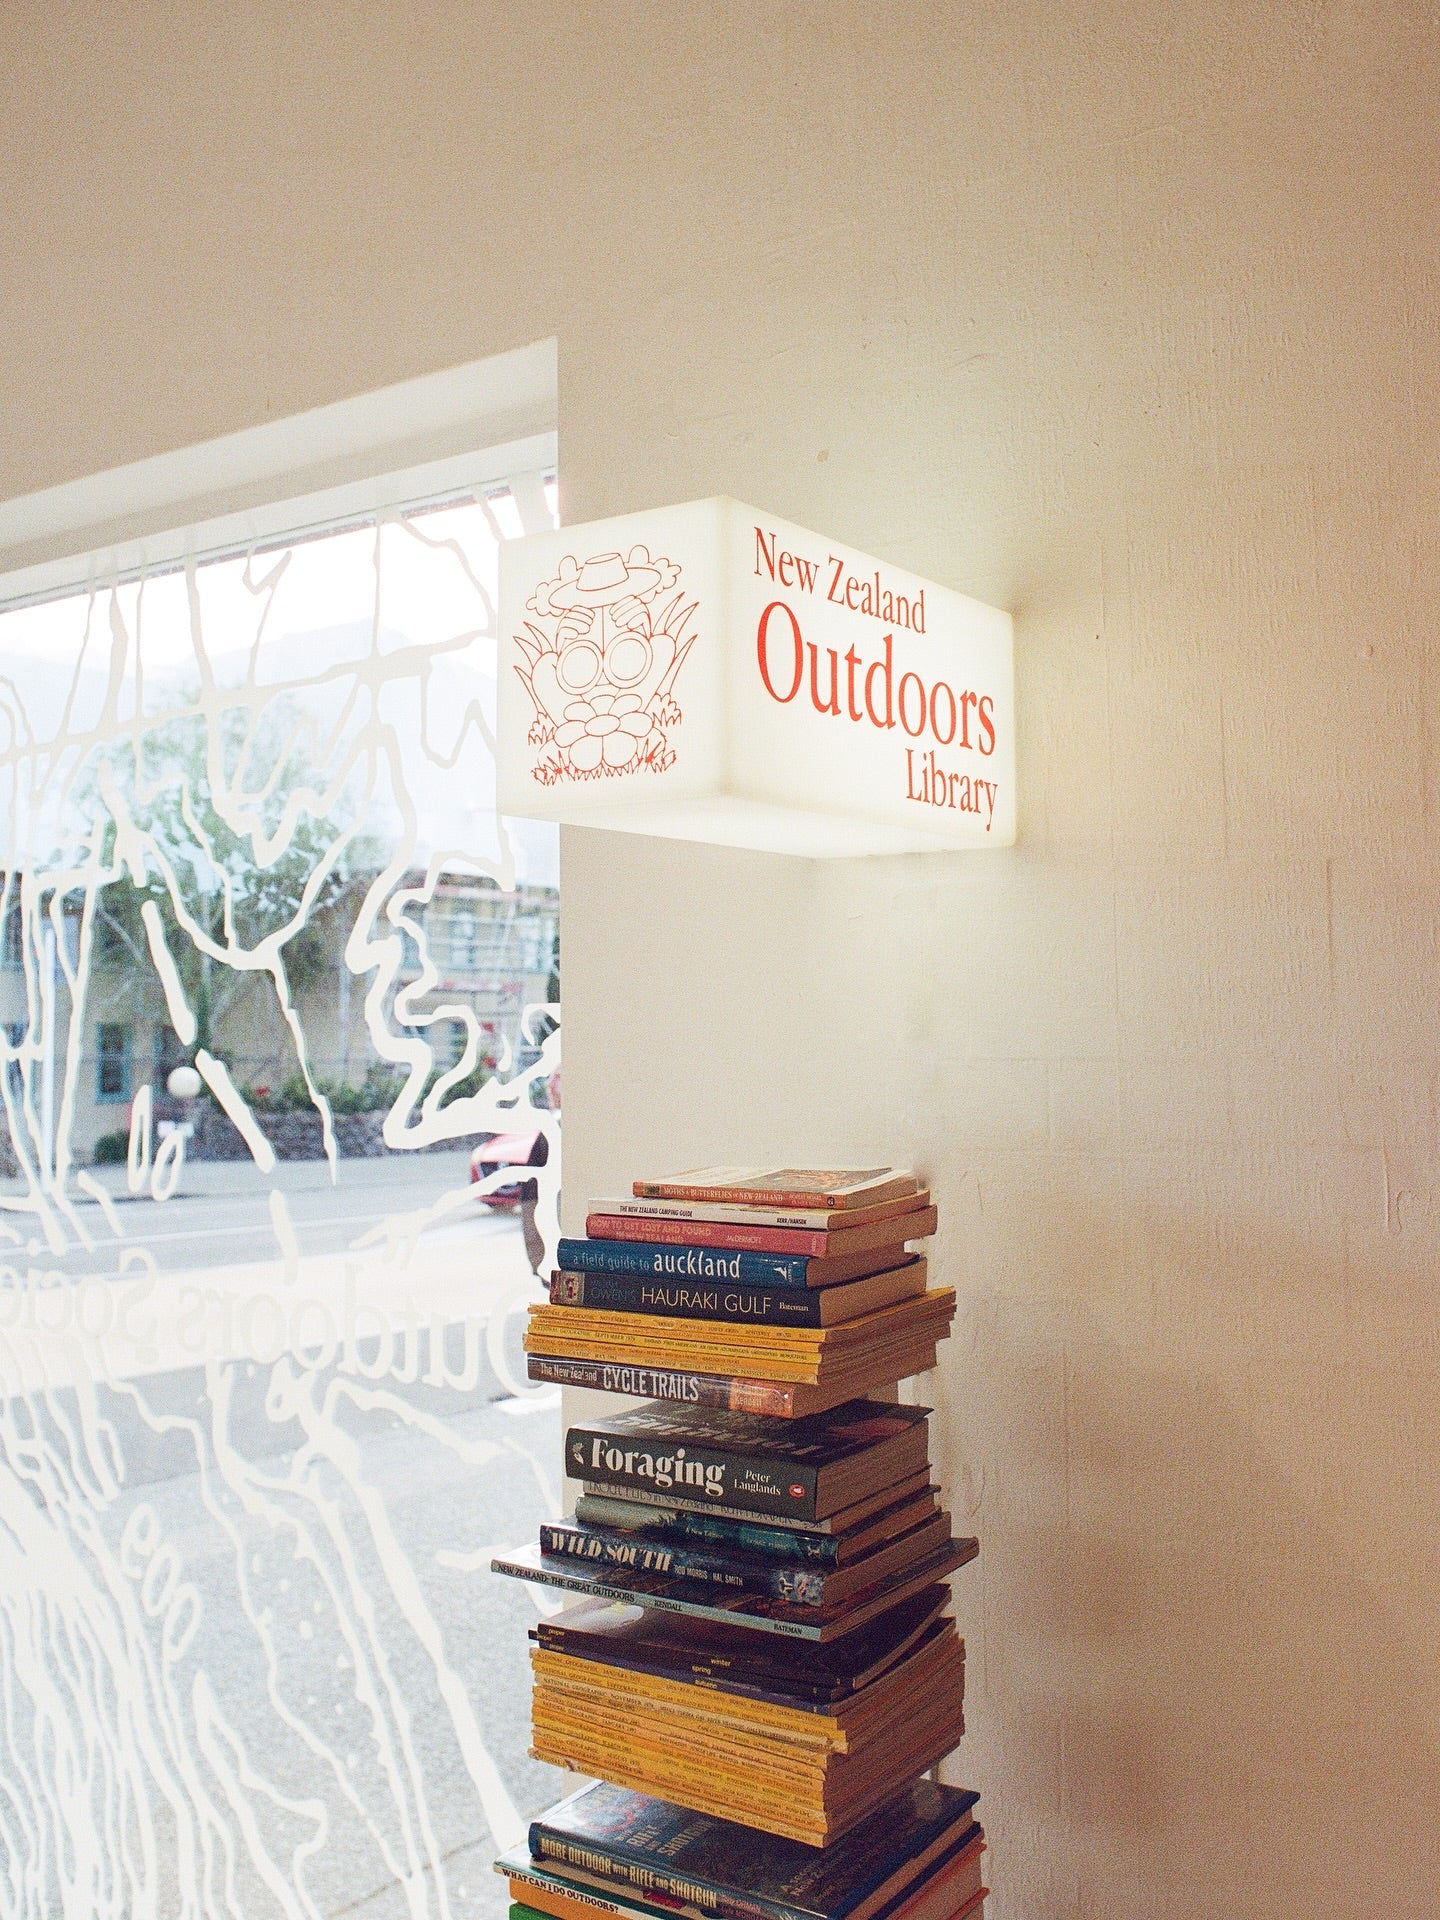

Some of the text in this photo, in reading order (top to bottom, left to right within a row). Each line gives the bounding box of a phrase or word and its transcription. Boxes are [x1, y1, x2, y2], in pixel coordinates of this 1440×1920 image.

[754, 526, 926, 634] New Zealand
[756, 601, 996, 756] Outdoors
[905, 748, 998, 831] Library
[664, 1186, 684, 1196] MOTHS
[690, 1188, 732, 1198] BUTTERFLIES
[739, 1191, 754, 1200] NEW
[754, 1192, 783, 1201] ZEALAND
[591, 1220, 711, 1236] HOW TO GET LOST AND FOUND
[619, 1205, 693, 1218] THE NEW ZEALAND CAMPING GUIDE
[645, 1233, 684, 1244] ZEALAND
[573, 1250, 741, 1279] a field guide to auckland
[642, 1286, 717, 1311] HAURAKI
[724, 1294, 771, 1315] GULF
[779, 1302, 809, 1312] Bateman
[541, 1363, 553, 1375] The
[554, 1365, 569, 1378] New
[569, 1367, 598, 1381] Zealand
[603, 1366, 648, 1394] CYCLE
[648, 1373, 700, 1401] TRAILS
[591, 1437, 726, 1497] Foraging
[745, 1470, 771, 1484] Peter
[734, 1479, 781, 1496] Langlands
[550, 1531, 602, 1558] WILD
[606, 1543, 672, 1572] SOUTH
[686, 1567, 708, 1580] MORRIS
[712, 1572, 724, 1583] HAL
[725, 1575, 744, 1586] SMITH
[498, 1564, 802, 1635] NEW ZEALAND: THE GREAT OUTDOORS KENDALL BATEMAN
[692, 1665, 711, 1676] spring
[541, 1837, 567, 1861] MORE
[568, 1847, 612, 1875] OUTDOOR
[613, 1863, 628, 1876] WITH
[629, 1865, 654, 1889] RIFLE
[655, 1877, 669, 1890] AND
[670, 1880, 717, 1908] SHOTGUN
[502, 1868, 619, 1914] WHAT CAN I DO OUTDOORS?
